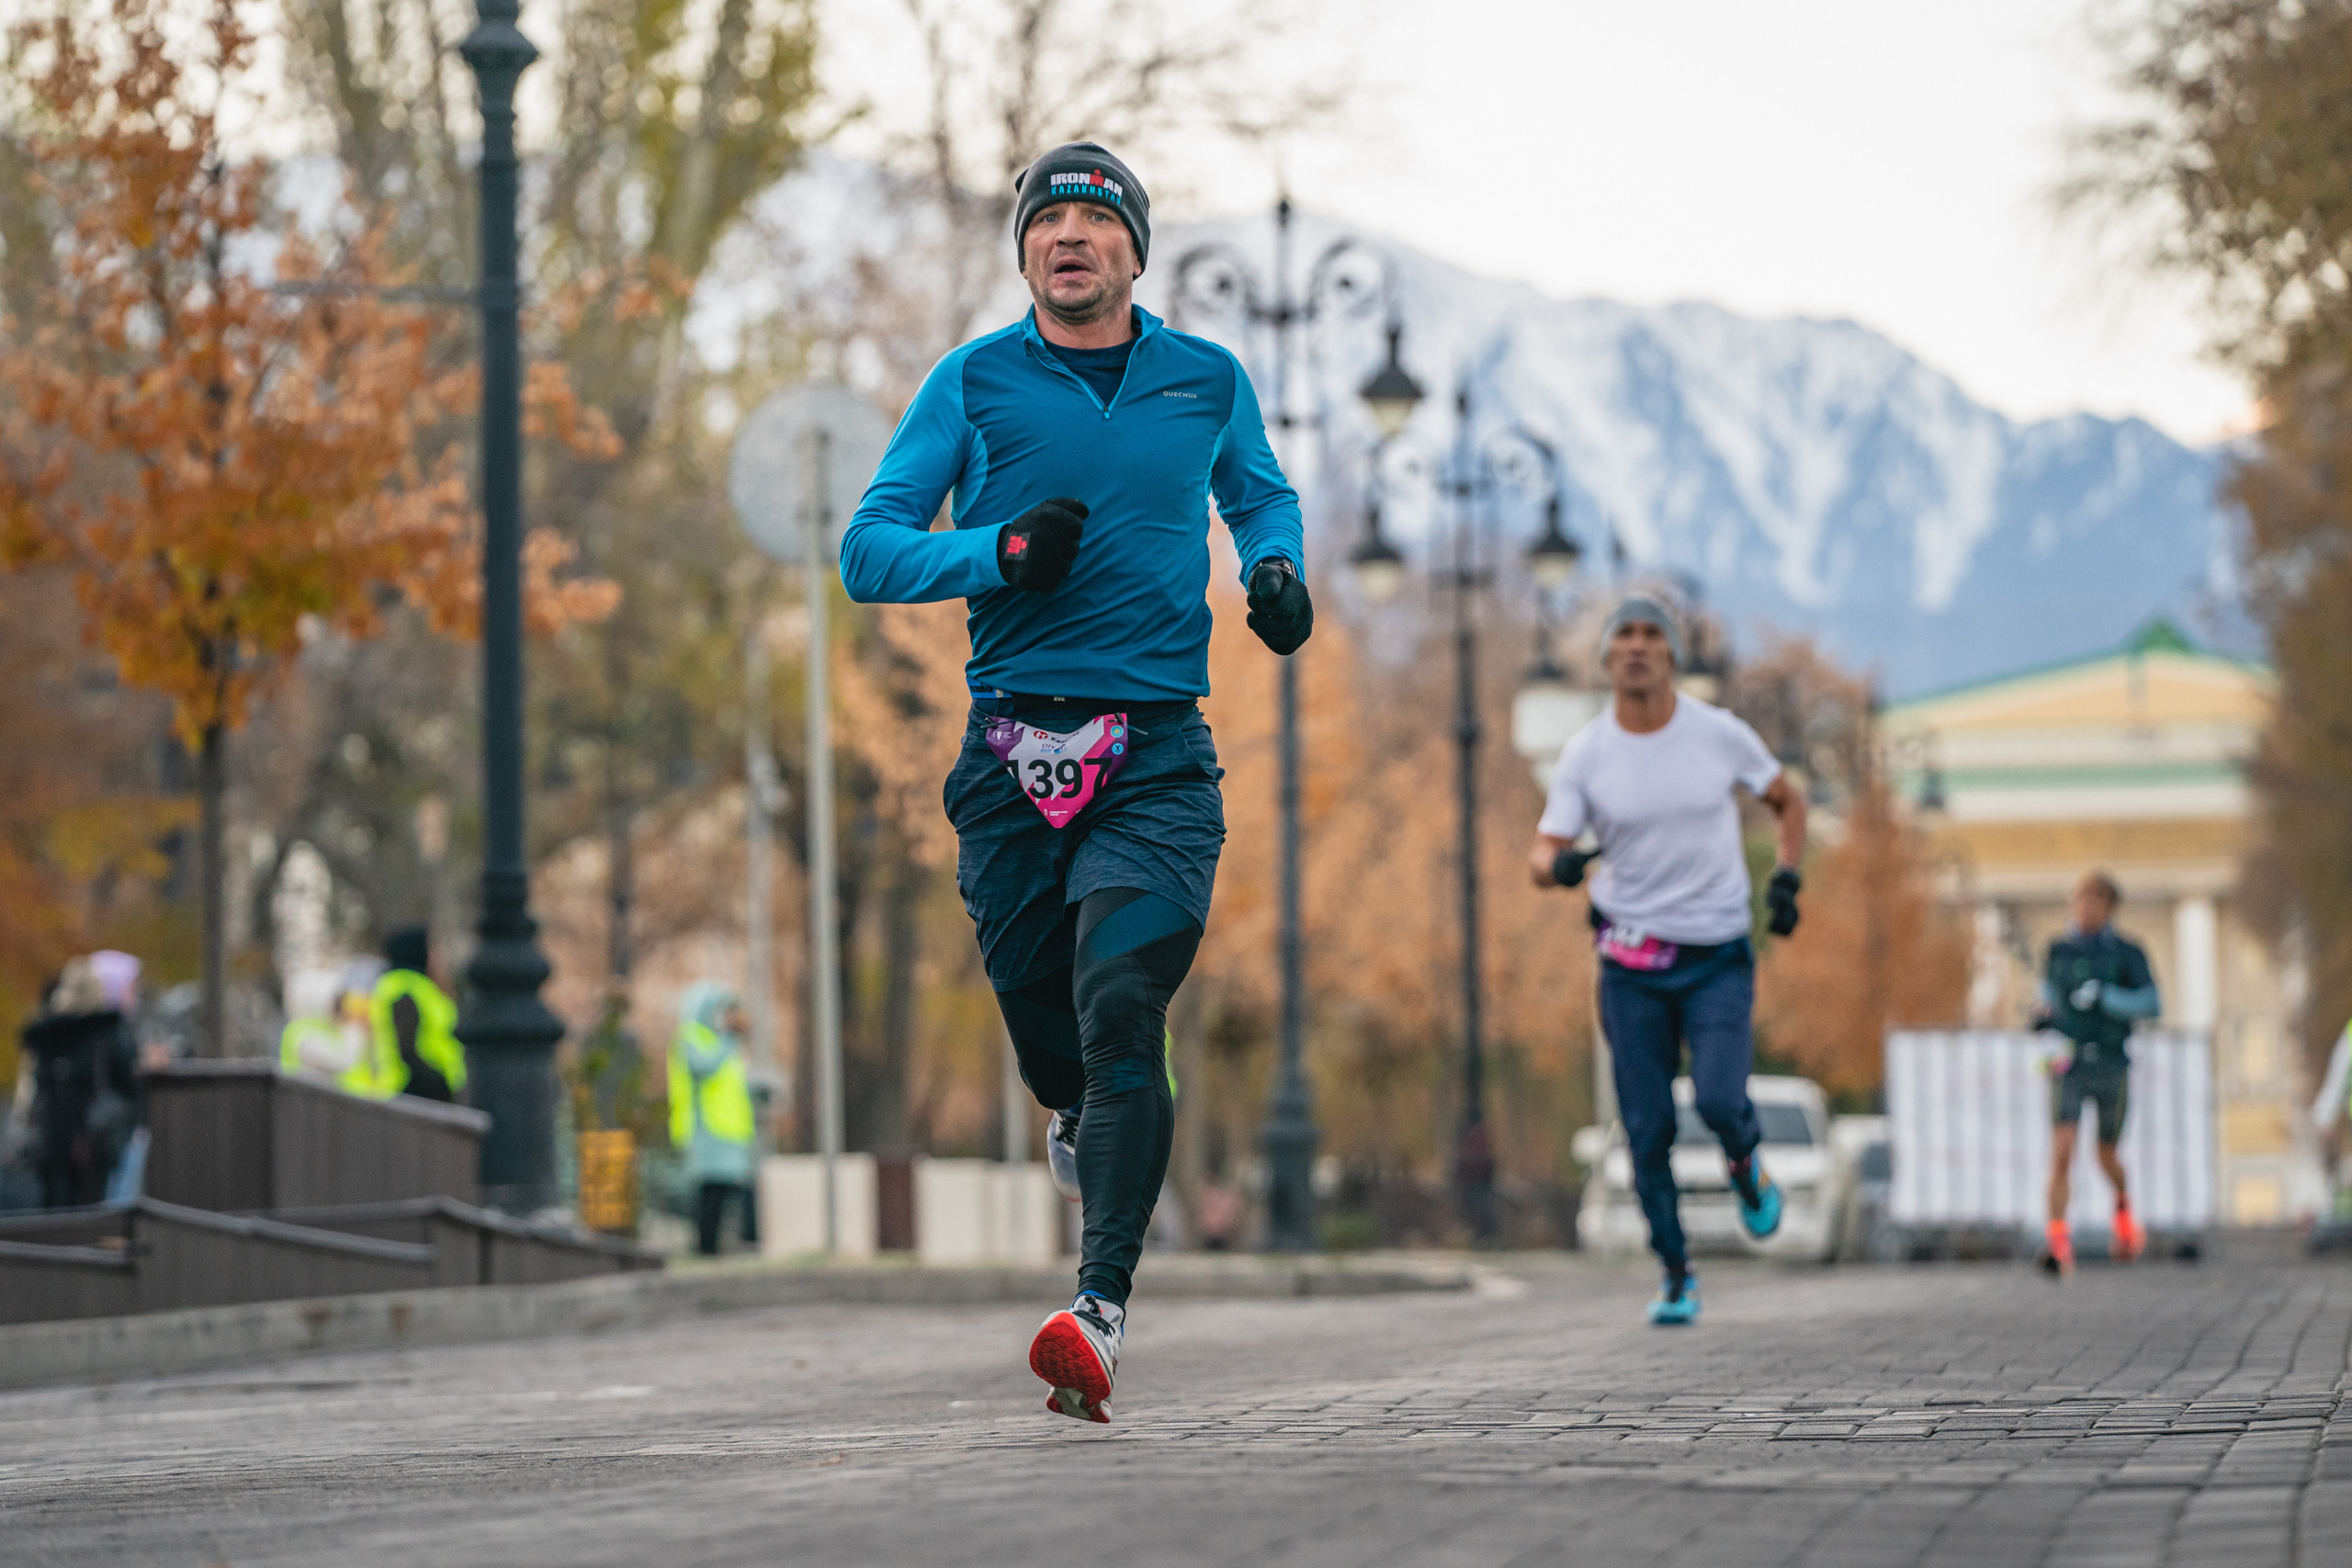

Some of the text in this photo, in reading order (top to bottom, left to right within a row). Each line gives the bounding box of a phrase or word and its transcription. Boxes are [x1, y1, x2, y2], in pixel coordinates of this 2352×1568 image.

[1050, 169, 1123, 197] IRONMAN
[1051, 185, 1122, 205] KAZAKHSTAN
[1163, 390, 1197, 399] QUECHUA
[1004, 758, 1113, 799] 1397
